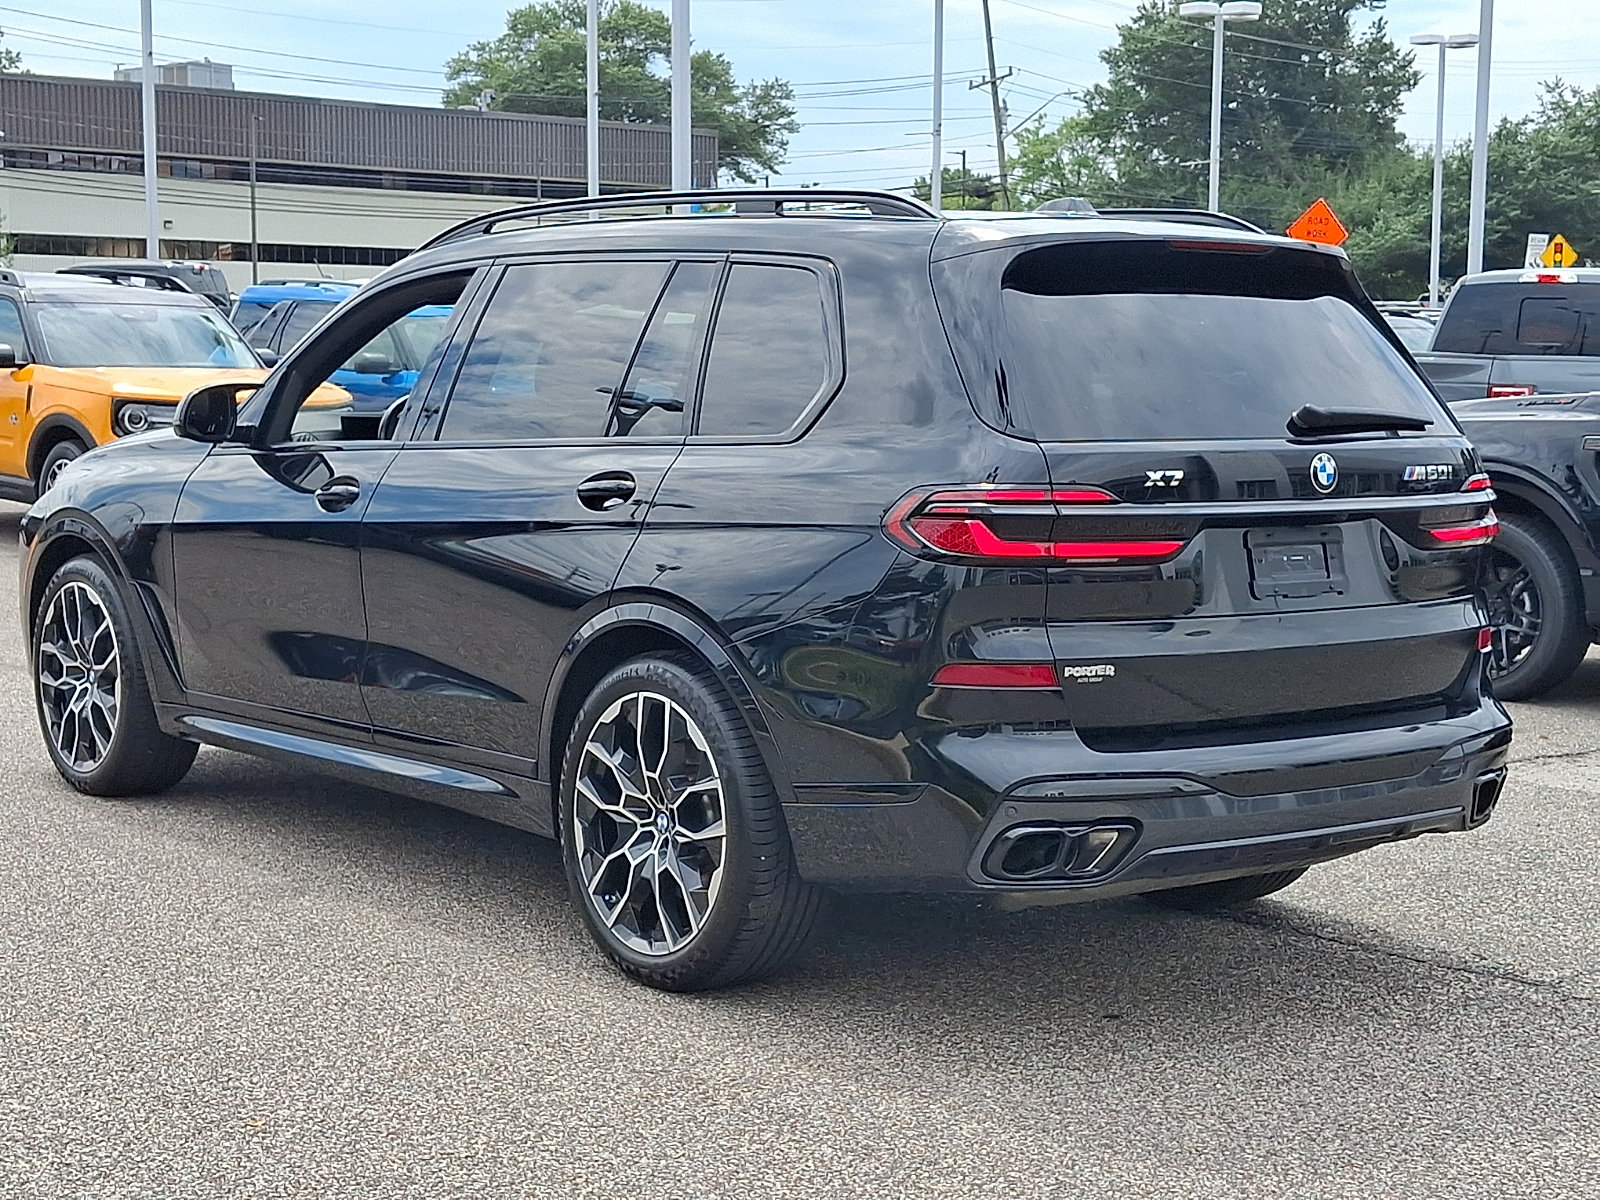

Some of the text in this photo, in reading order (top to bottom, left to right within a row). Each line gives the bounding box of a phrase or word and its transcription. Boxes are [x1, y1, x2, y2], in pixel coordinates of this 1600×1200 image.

[1308, 216, 1329, 225] ROAD
[1143, 470, 1184, 487] X7
[1064, 665, 1115, 677] PORTER
